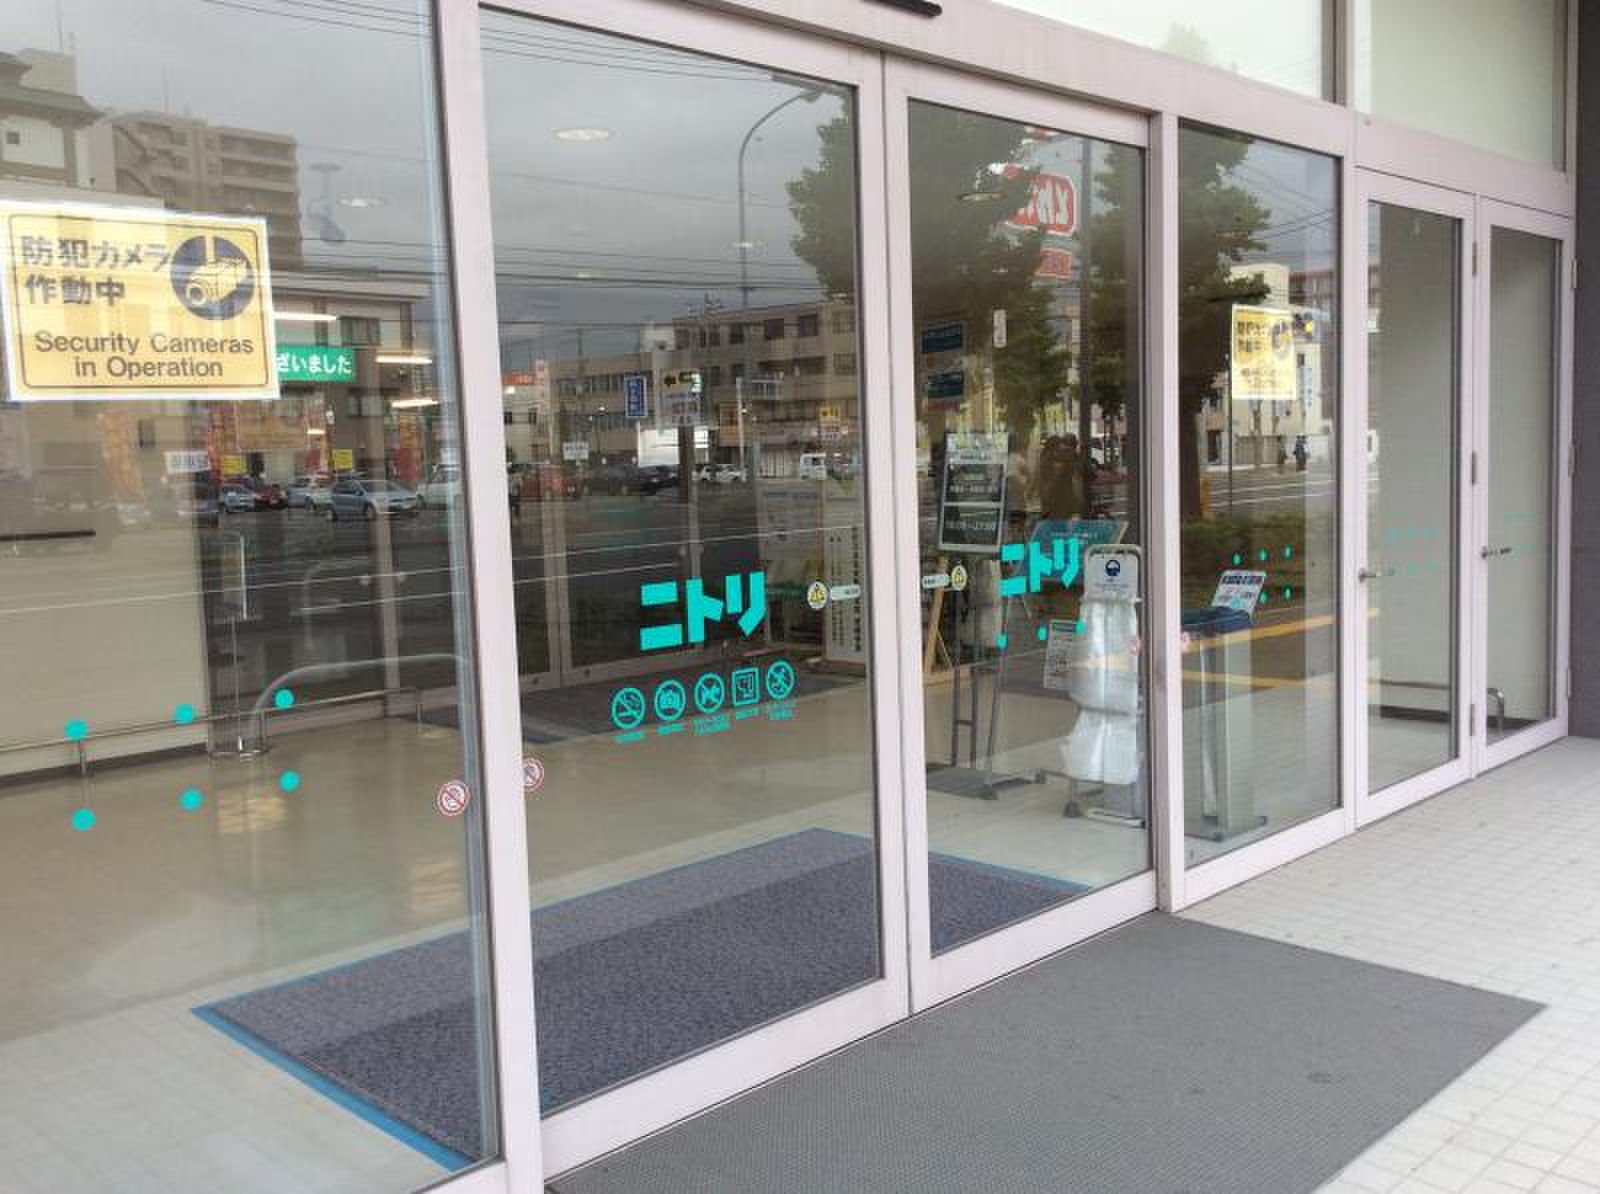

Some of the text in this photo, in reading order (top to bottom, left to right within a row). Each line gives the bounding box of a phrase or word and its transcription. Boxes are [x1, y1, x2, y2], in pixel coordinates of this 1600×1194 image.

[20, 235, 171, 272] 防犯カメラ
[25, 273, 125, 306] 作動中
[35, 330, 254, 355] Security Cameras
[74, 355, 224, 380] in Operation
[1000, 536, 1080, 598] ニトリ
[639, 570, 767, 651] ニトリ
